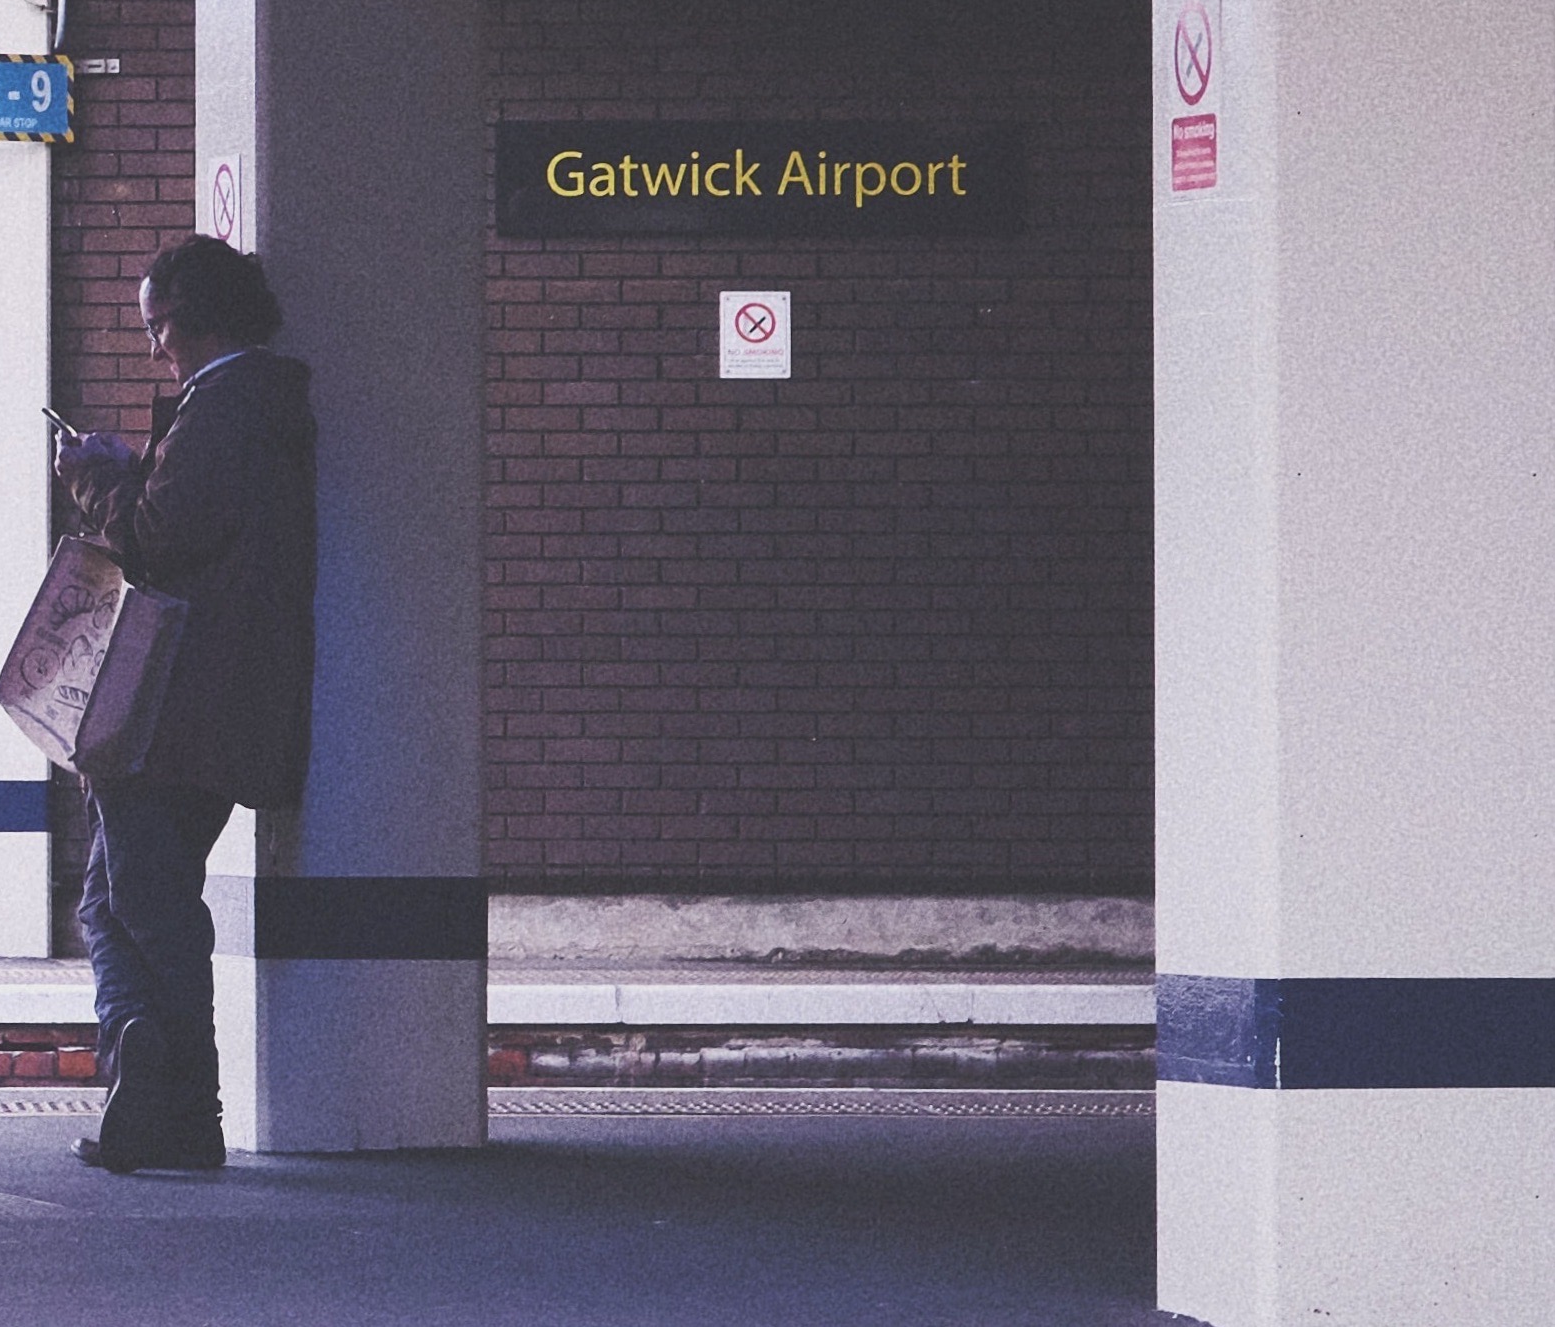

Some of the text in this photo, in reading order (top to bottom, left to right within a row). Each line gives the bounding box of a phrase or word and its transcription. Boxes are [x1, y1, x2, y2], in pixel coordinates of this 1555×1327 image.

[30, 69, 52, 113] 9
[13, 117, 38, 128] STOP
[545, 148, 968, 209] Gatwick Airport
